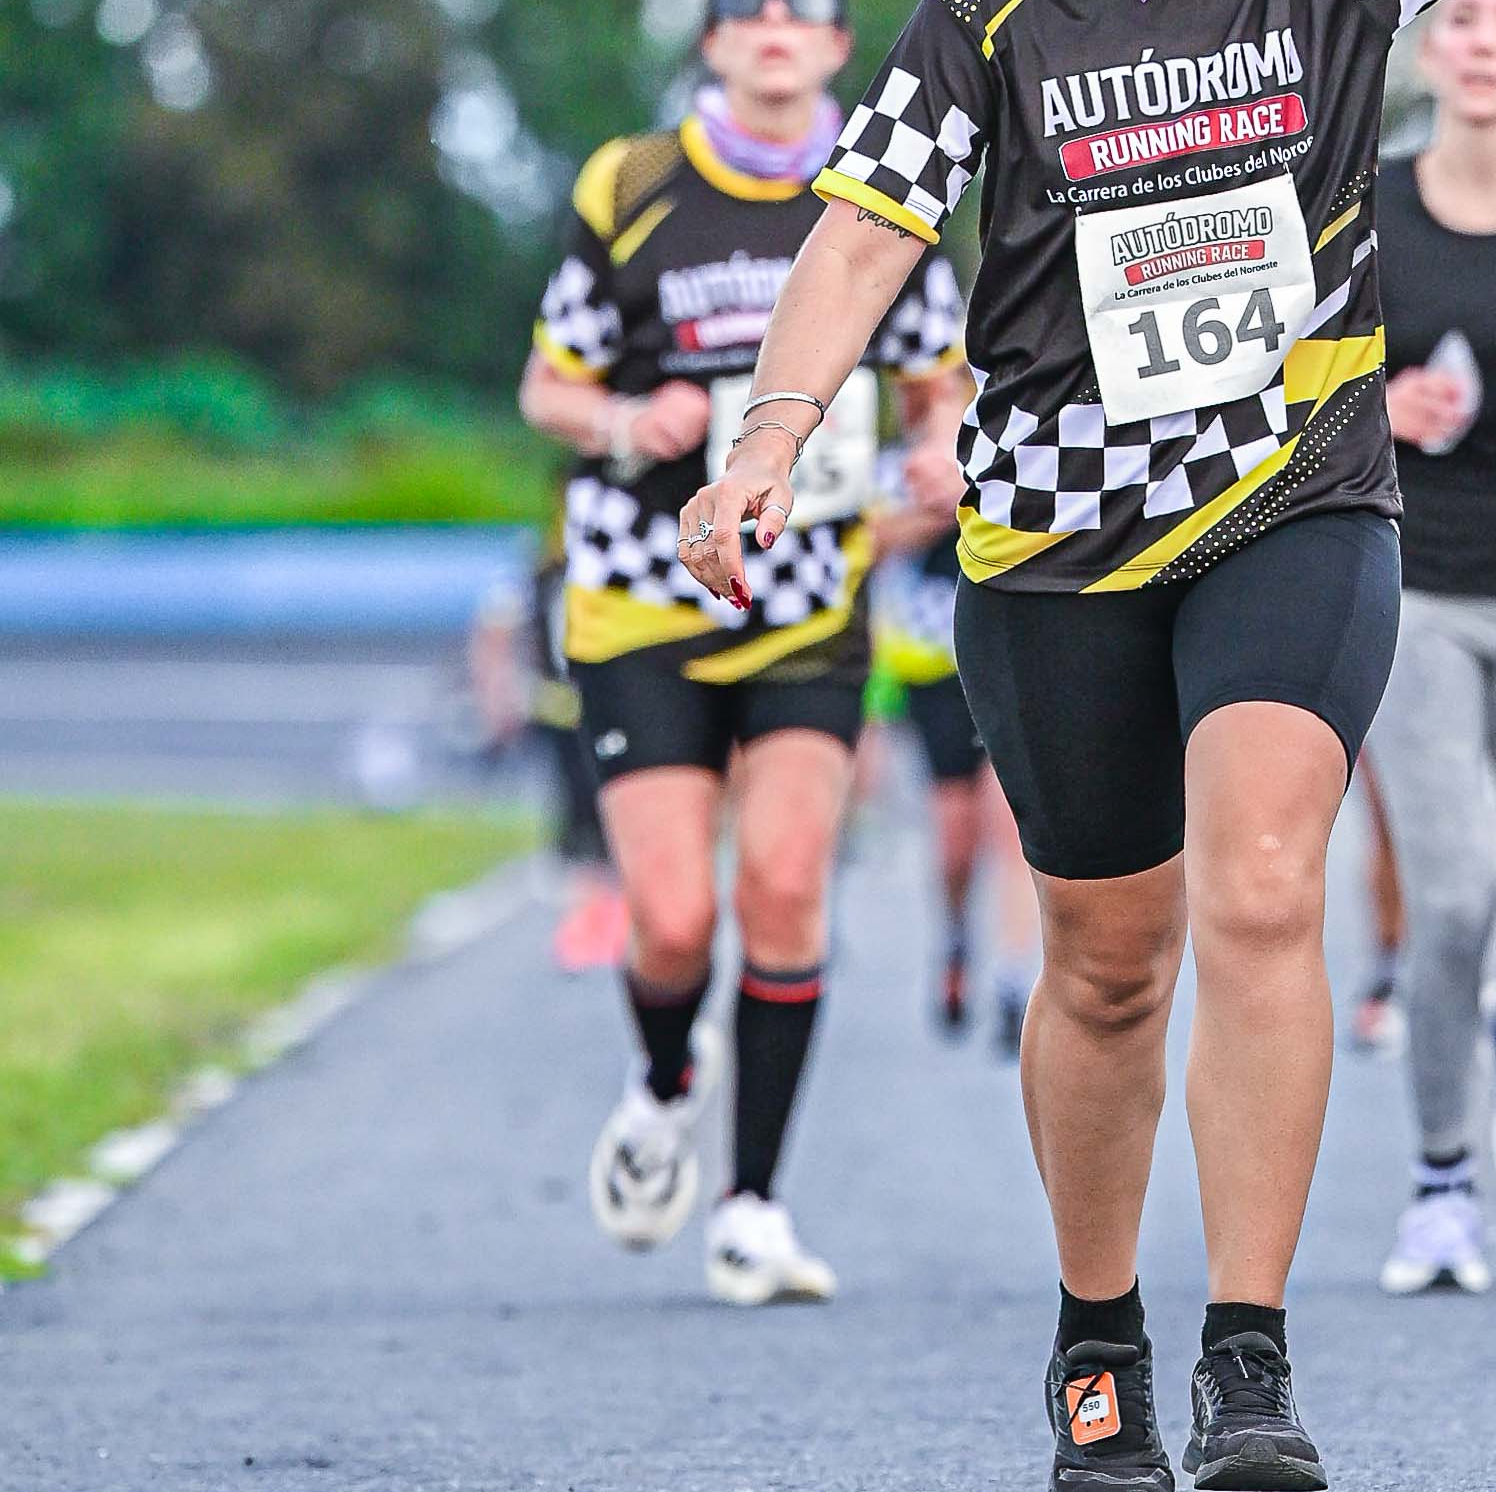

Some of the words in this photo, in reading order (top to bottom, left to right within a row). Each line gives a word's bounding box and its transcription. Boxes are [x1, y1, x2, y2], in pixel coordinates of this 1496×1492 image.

[1041, 27, 1304, 138] AUTÓDROMO
[1088, 115, 1212, 172] RUNNING
[1218, 103, 1285, 144] RACE
[1046, 189, 1066, 203] La
[1067, 185, 1128, 203] Carrera
[1132, 178, 1154, 195] de
[1158, 174, 1182, 190] los
[1185, 163, 1241, 185] Clubes
[1244, 151, 1267, 173] del
[1110, 207, 1273, 266] AUTÓDROMO
[1139, 249, 1207, 280] RUNNING
[1212, 244, 1249, 262] RACE
[1115, 292, 1125, 300] La
[1127, 285, 1161, 298] Carrera
[1163, 281, 1174, 290] de
[1176, 278, 1189, 287] los
[1192, 273, 1222, 284] Clubes
[1224, 268, 1238, 278] del
[1240, 261, 1278, 275] Noroeste
[1128, 287, 1285, 379] 164
[1082, 1400, 1100, 1413] 550
